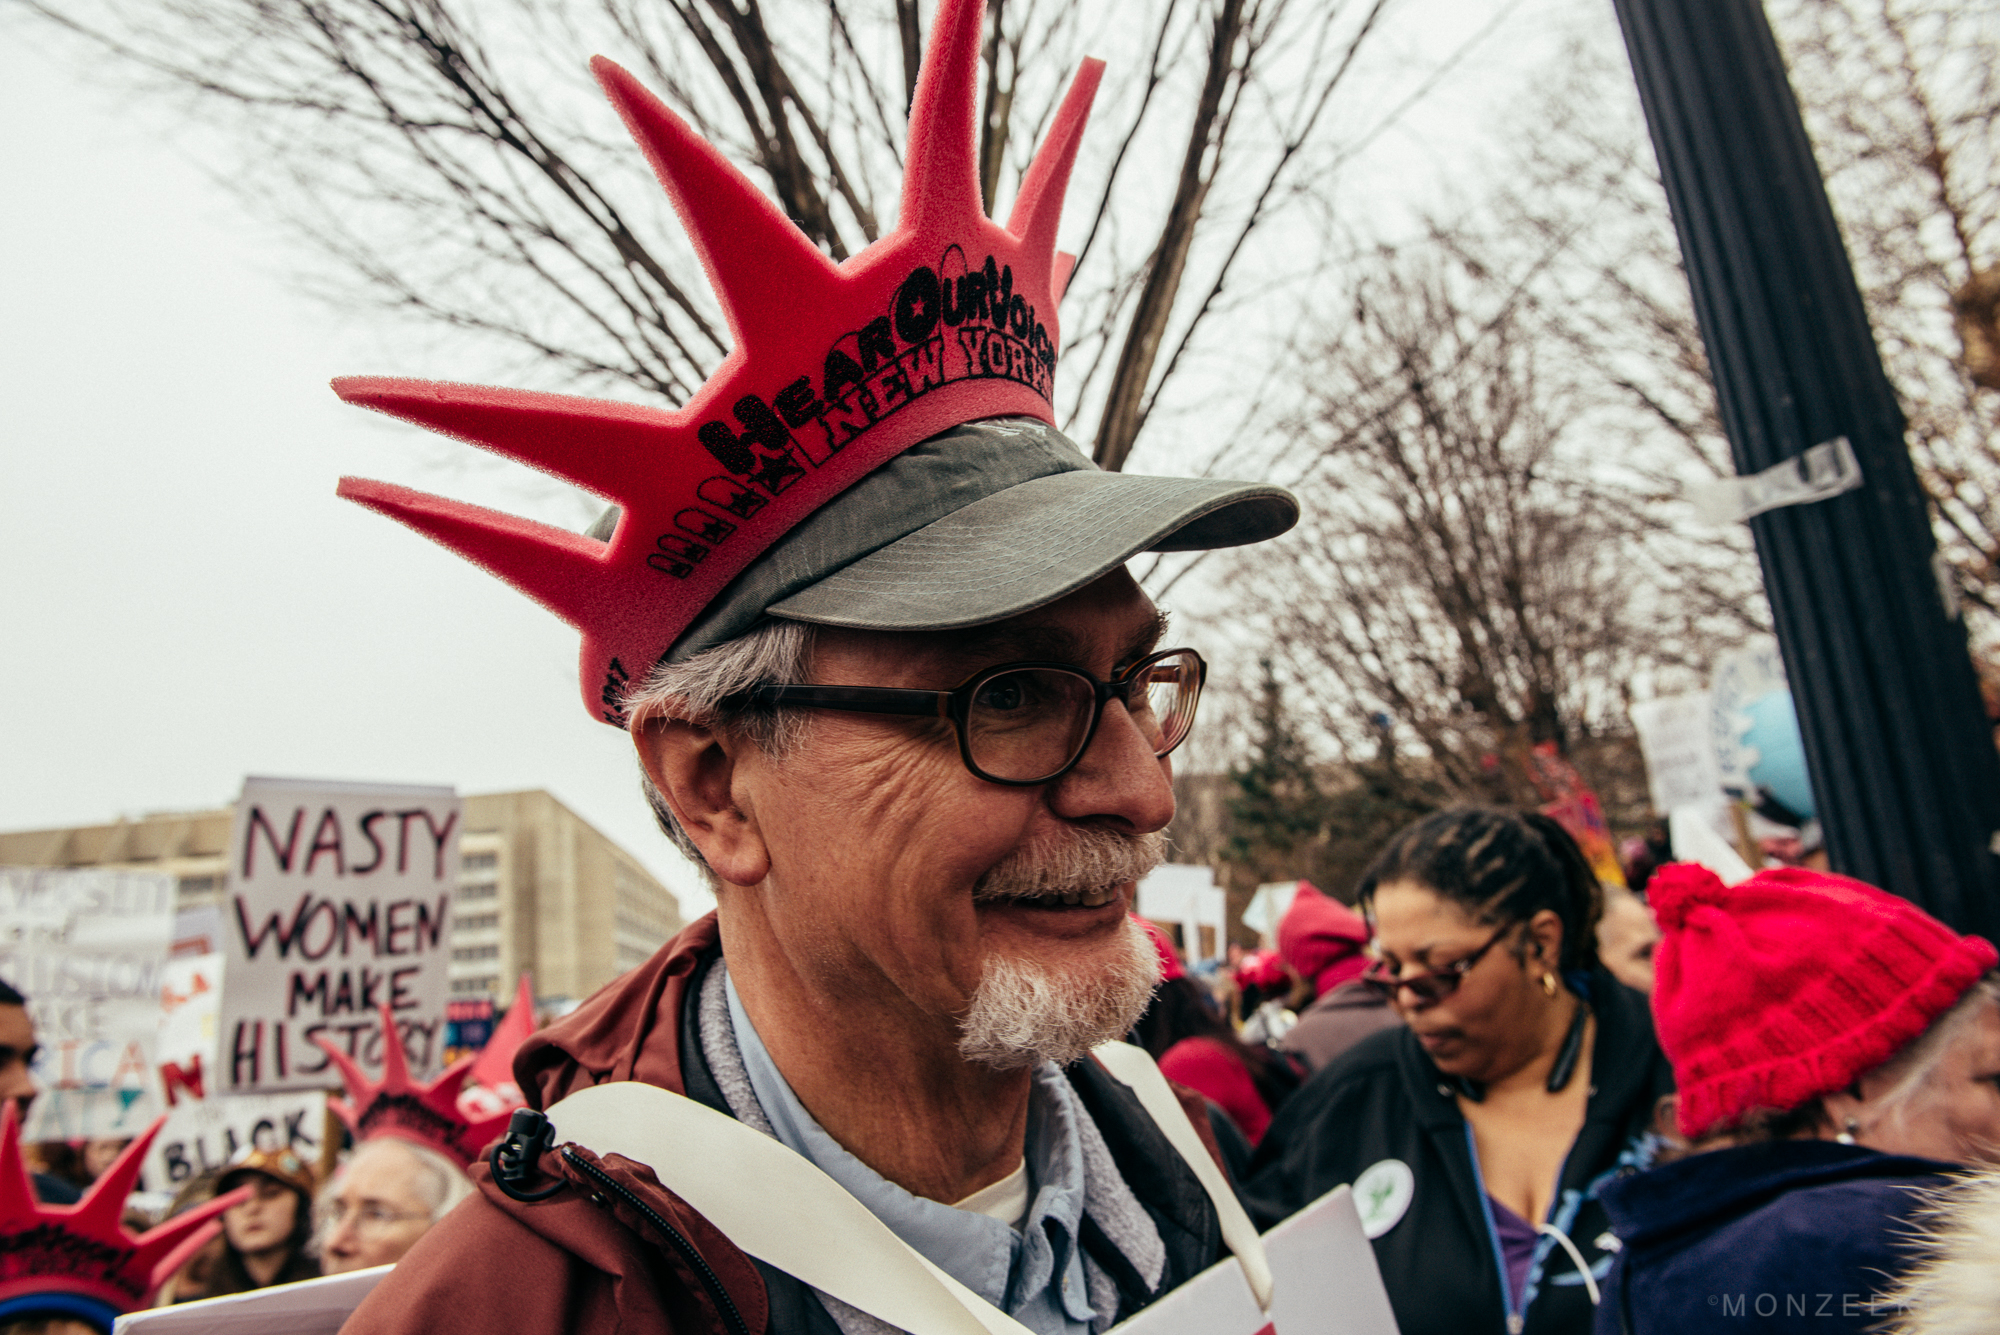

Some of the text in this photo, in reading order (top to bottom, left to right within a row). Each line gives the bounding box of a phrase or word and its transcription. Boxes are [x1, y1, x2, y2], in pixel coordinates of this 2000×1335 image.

[820, 326, 1052, 454] NEW YORK
[242, 803, 459, 880] NASTY
[233, 892, 448, 961] WOMEN
[287, 965, 421, 1018] MAKE
